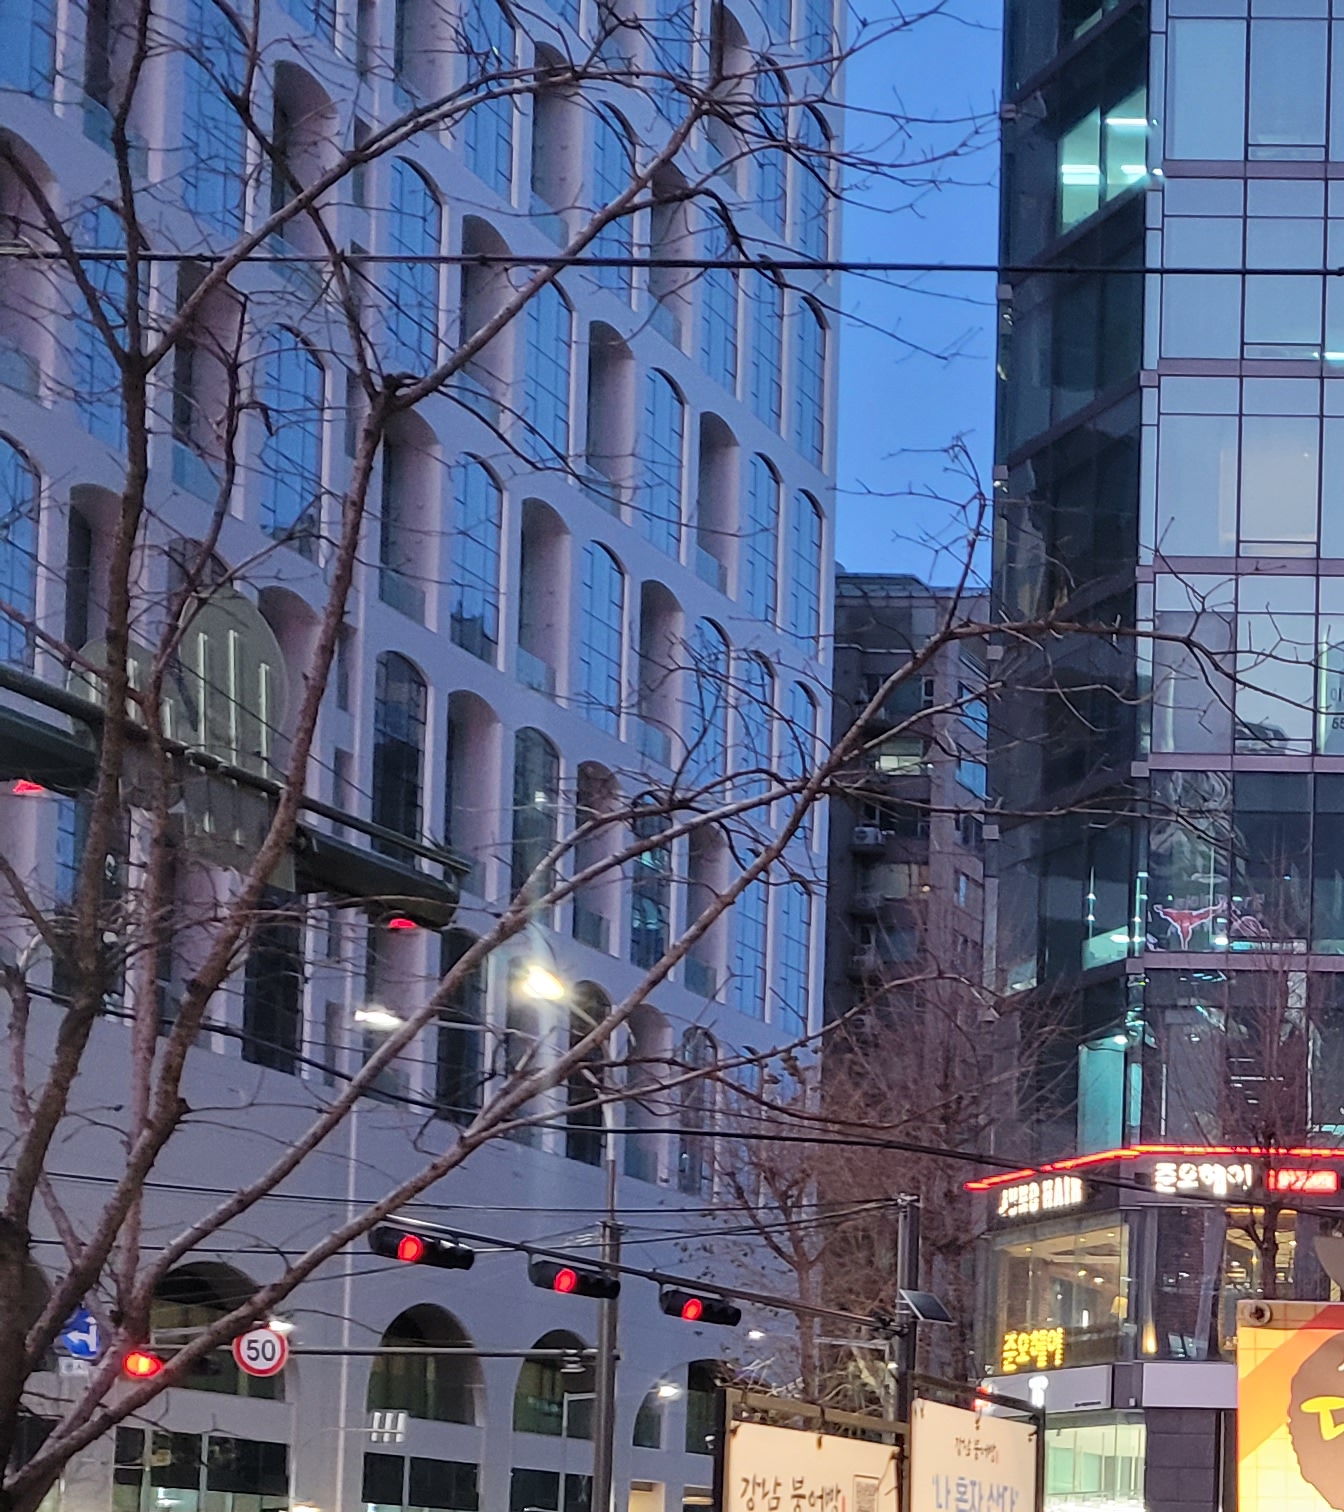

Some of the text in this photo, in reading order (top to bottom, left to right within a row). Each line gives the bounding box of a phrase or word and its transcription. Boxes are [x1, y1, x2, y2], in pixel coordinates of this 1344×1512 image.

[1042, 1175, 1083, 1209] HAIR
[246, 1341, 277, 1362] 50
[740, 1473, 781, 1512] 강남
